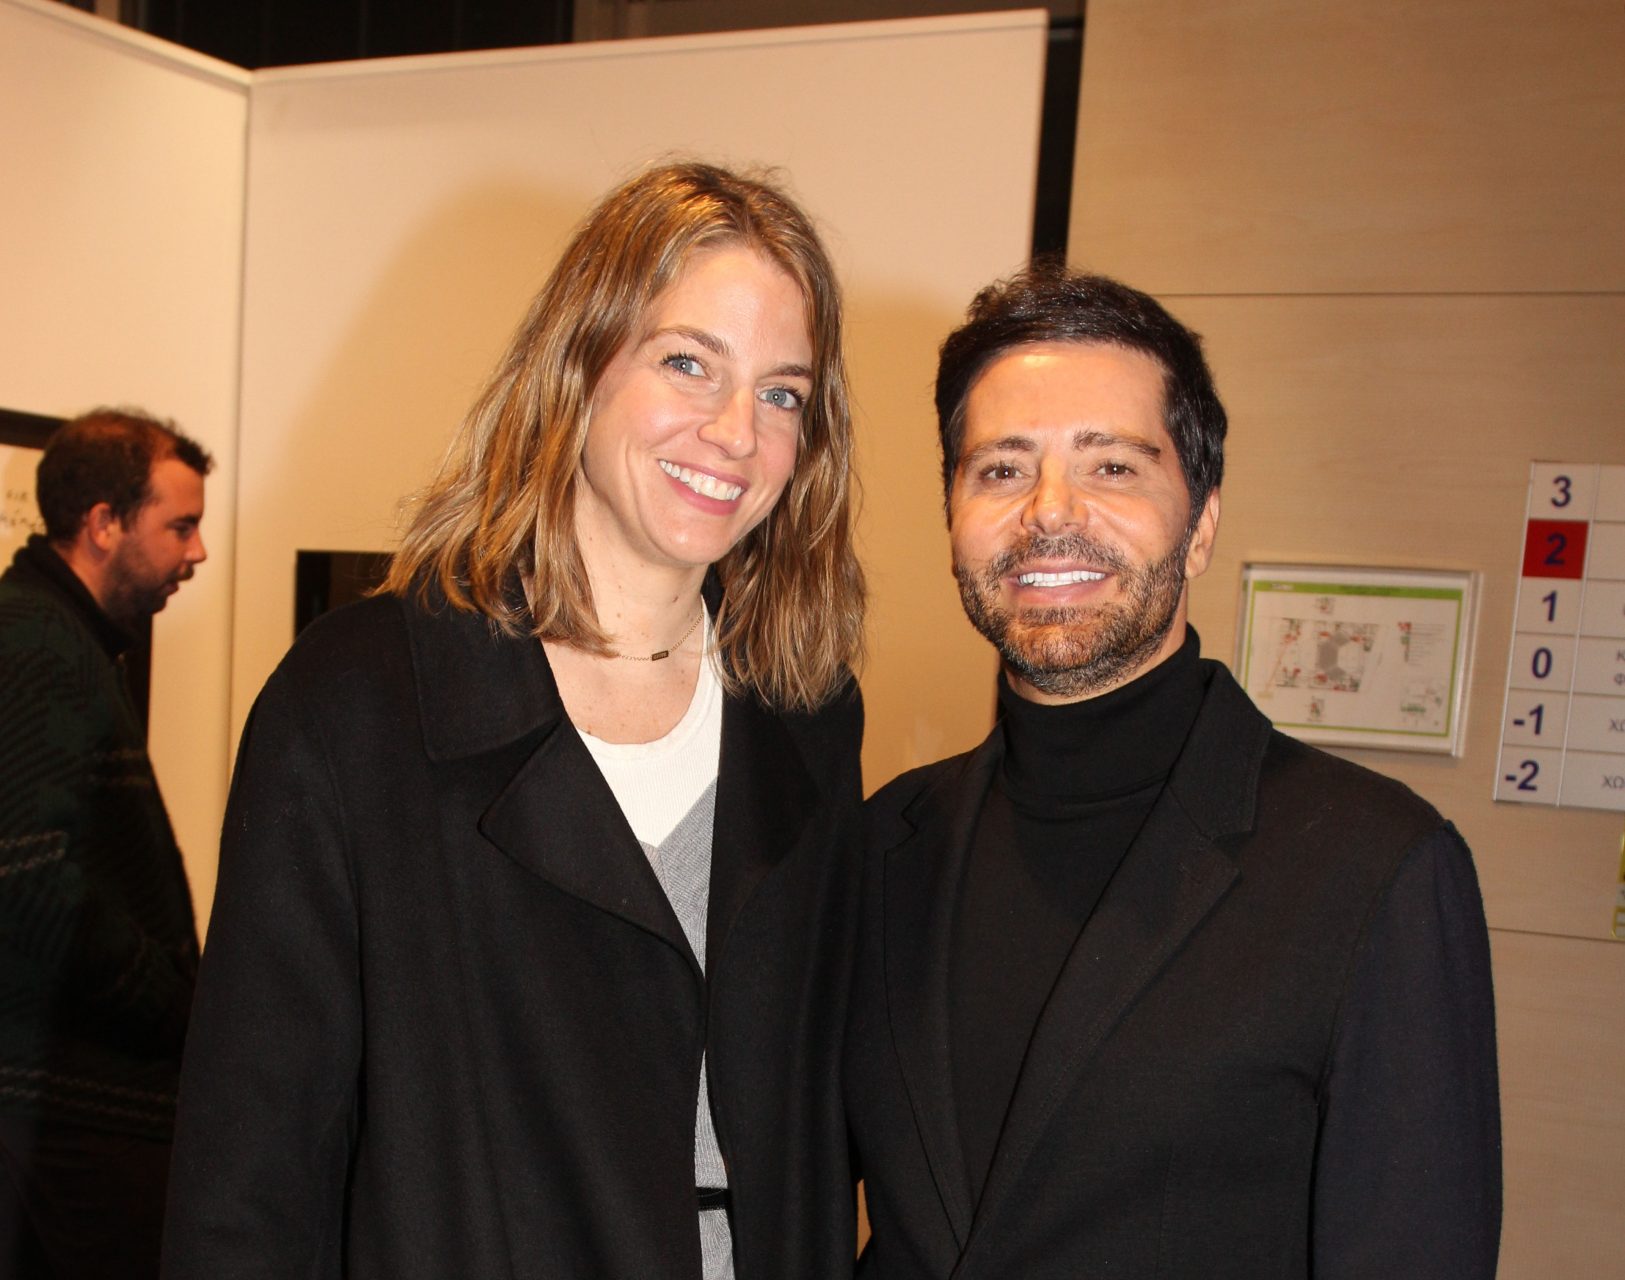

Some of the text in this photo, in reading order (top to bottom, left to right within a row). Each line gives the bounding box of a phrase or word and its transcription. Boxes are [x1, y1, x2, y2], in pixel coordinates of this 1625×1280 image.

[1551, 475, 1572, 508] 3
[1544, 532, 1568, 566] 2
[1541, 590, 1558, 623] 1
[1531, 647, 1553, 679] 0
[1513, 704, 1545, 736] -1
[1505, 759, 1540, 792] -2
